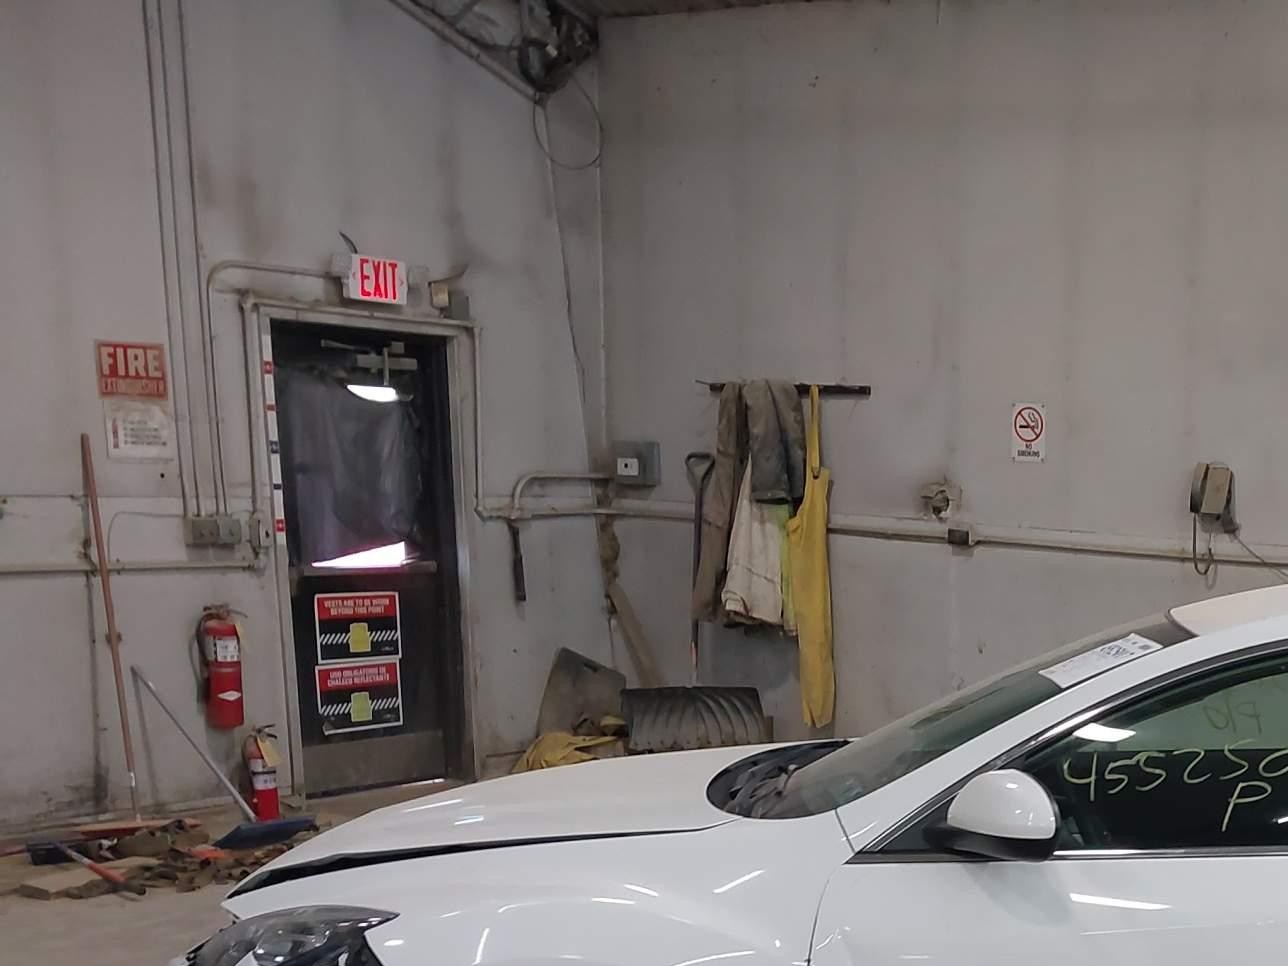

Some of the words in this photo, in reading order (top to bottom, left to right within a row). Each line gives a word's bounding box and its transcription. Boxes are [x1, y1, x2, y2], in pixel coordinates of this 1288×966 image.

[359, 257, 398, 301] EXIT
[99, 345, 163, 379] FIRE
[1221, 781, 1273, 832] P
